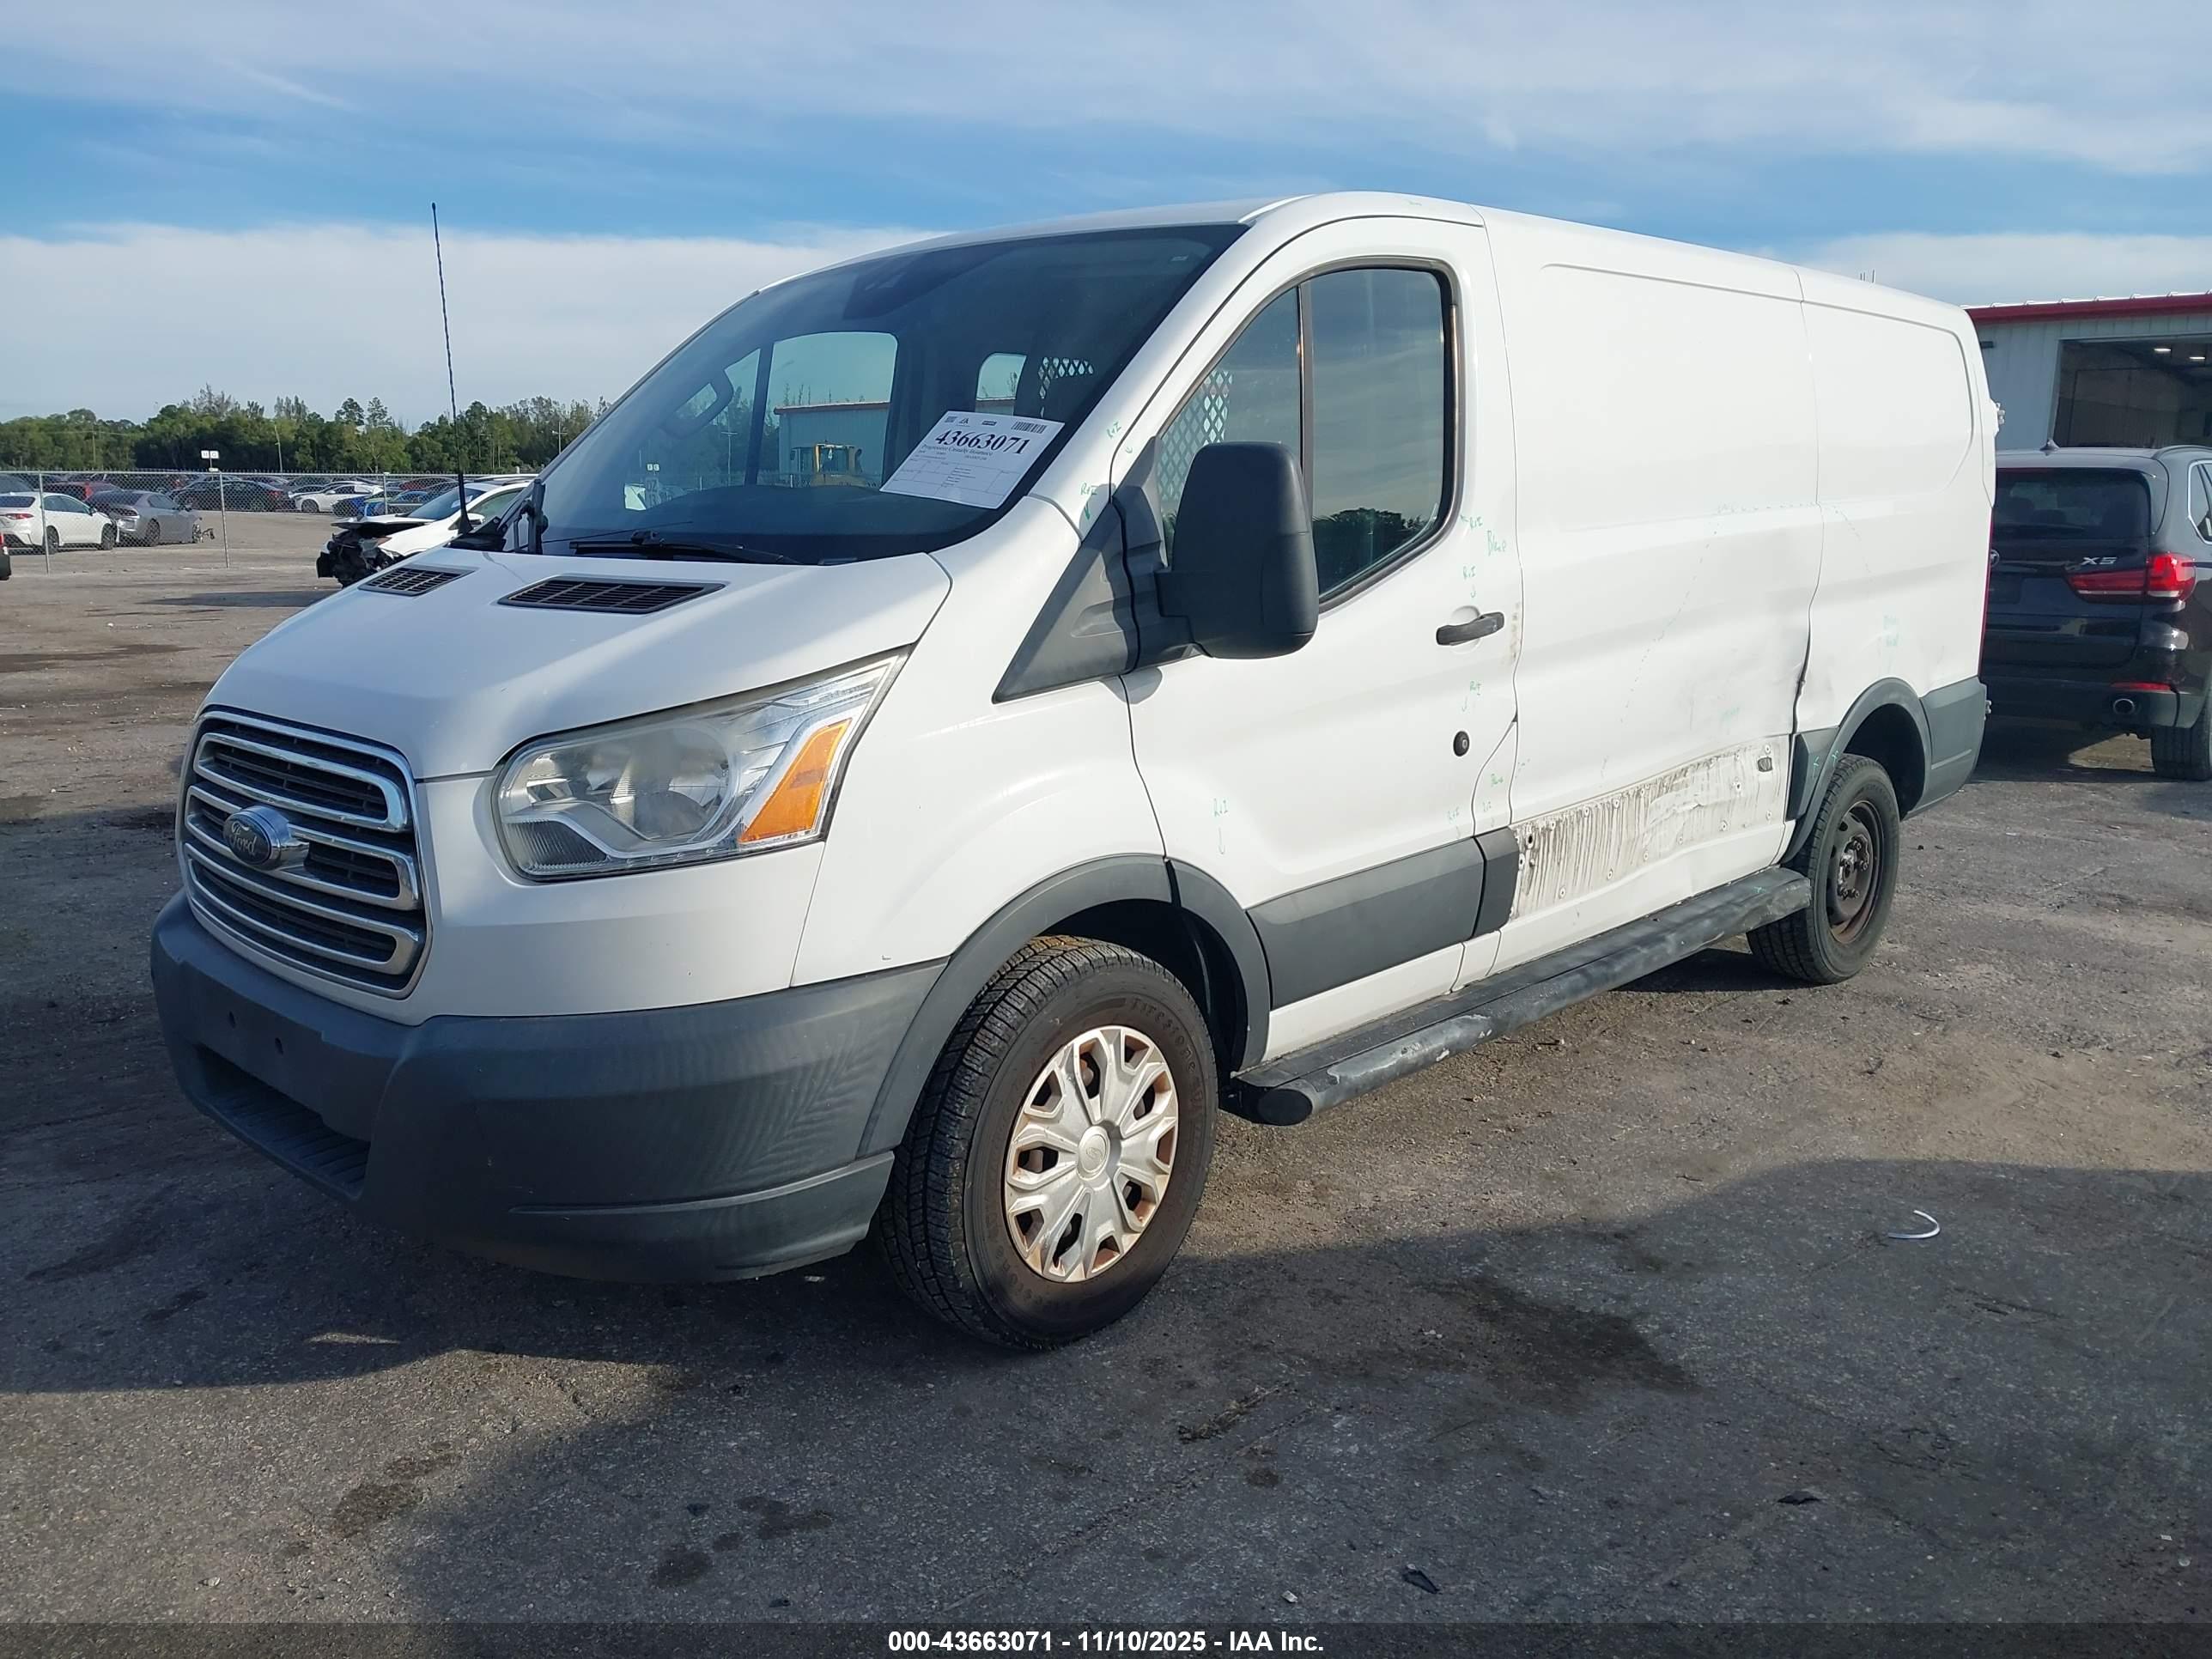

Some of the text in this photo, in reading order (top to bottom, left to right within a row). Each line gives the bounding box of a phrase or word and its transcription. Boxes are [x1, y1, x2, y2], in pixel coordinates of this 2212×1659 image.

[935, 429, 1030, 455] 43663071
[2081, 556, 2118, 565] X5
[229, 820, 258, 854] Ford
